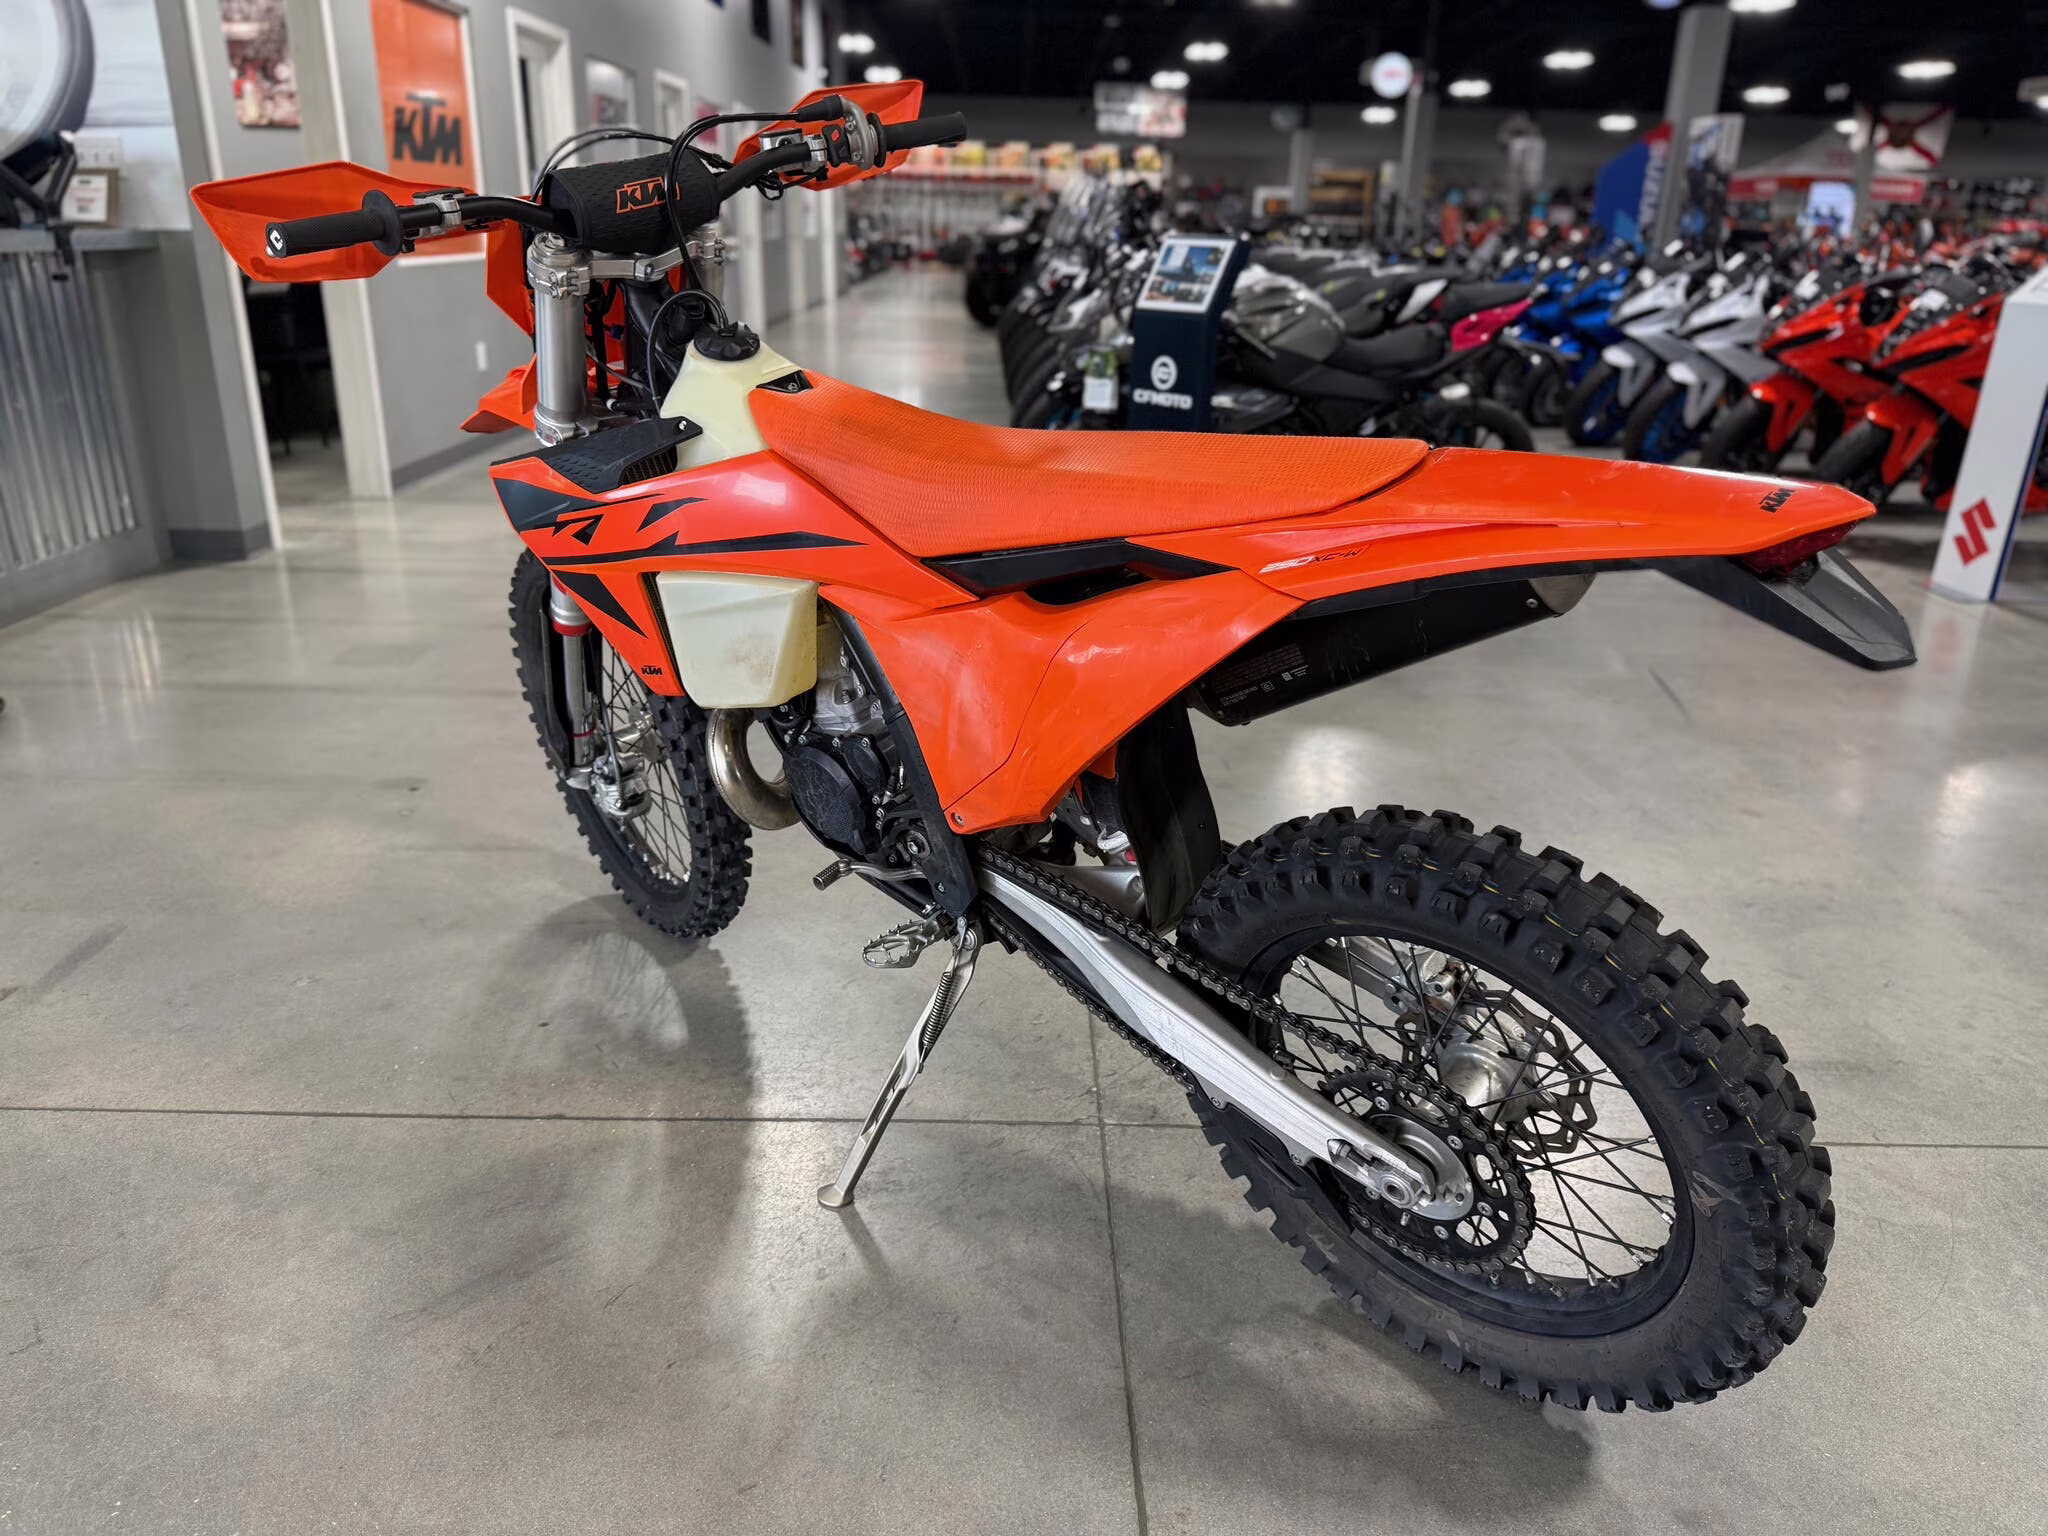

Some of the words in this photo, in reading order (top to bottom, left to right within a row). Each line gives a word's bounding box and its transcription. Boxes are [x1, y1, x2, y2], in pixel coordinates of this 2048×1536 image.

[393, 91, 464, 166] KTM
[1758, 487, 1796, 513] KTM
[641, 664, 664, 676] KTM
